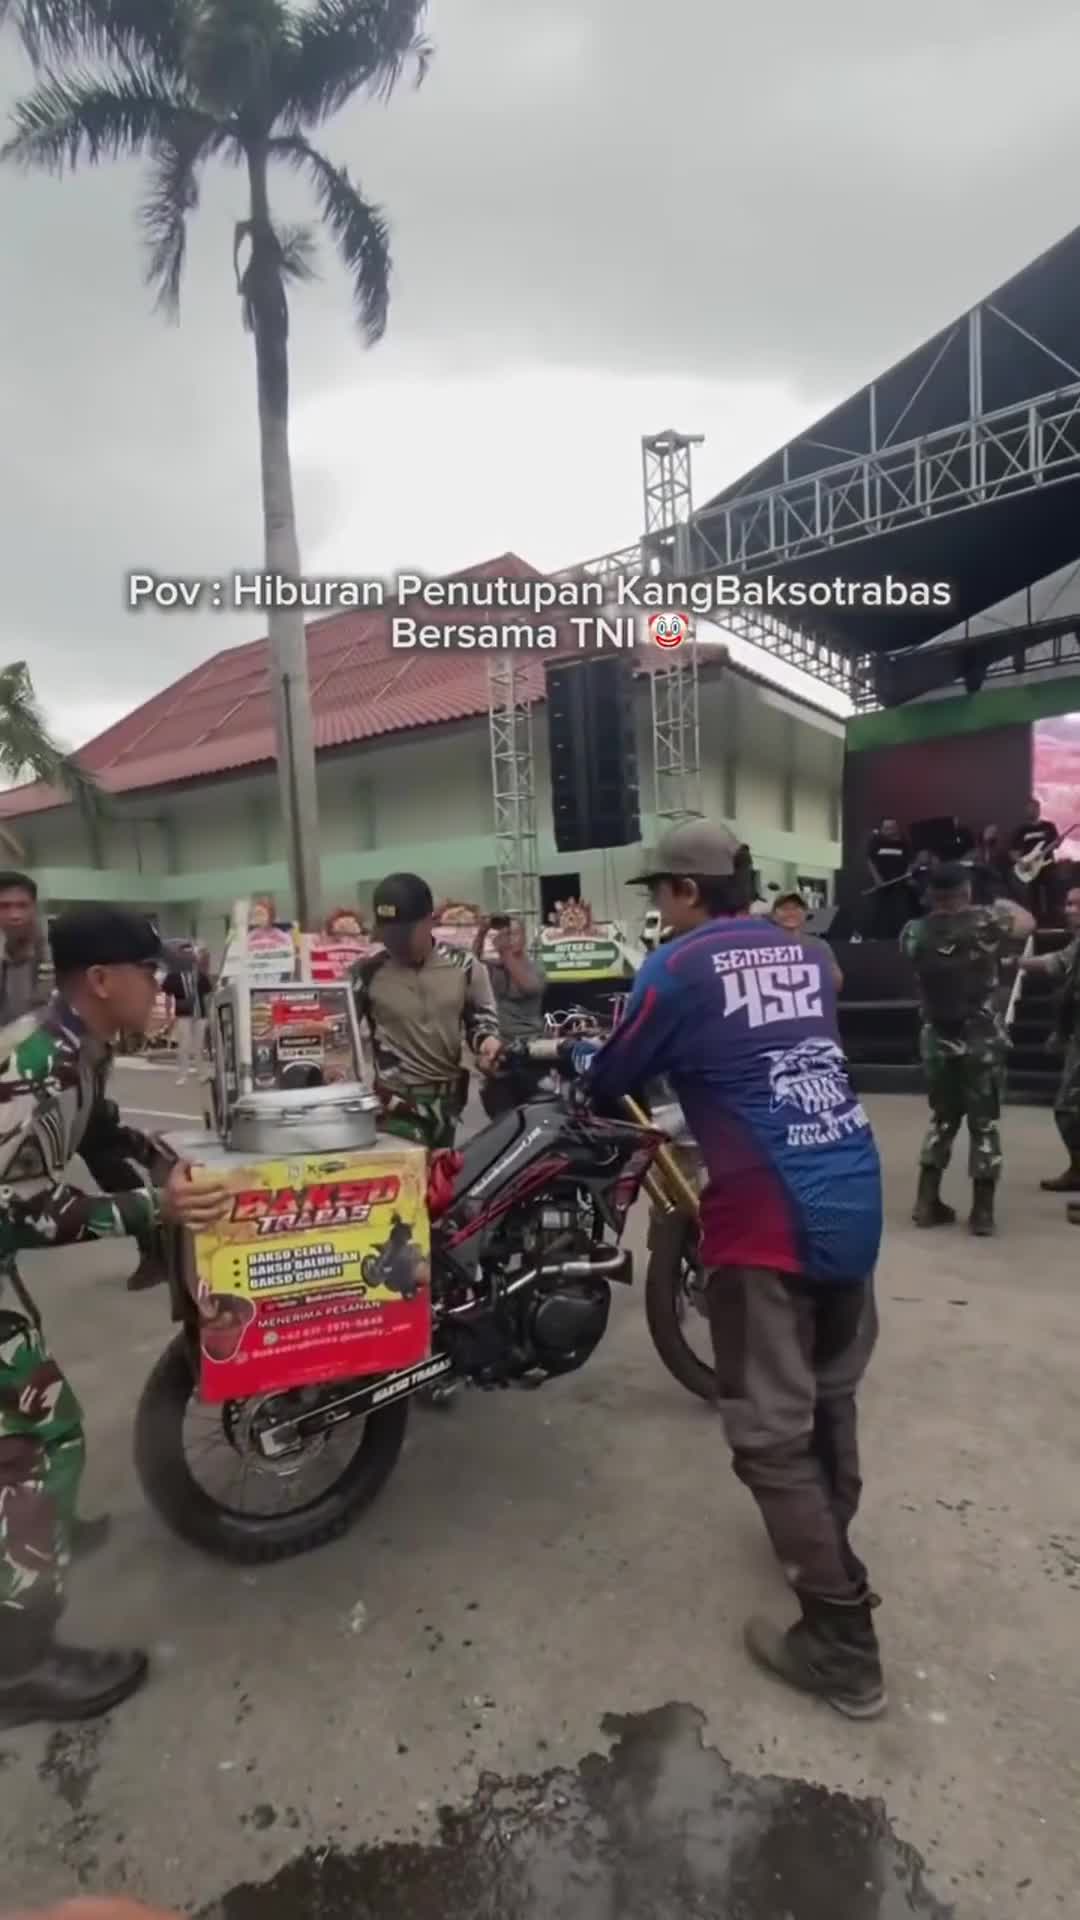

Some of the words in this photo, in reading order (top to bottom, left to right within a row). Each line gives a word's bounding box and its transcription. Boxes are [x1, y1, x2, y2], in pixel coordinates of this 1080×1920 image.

[712, 945, 803, 973] SENSEN
[722, 964, 823, 1028] 452
[231, 1176, 399, 1221] BAKSO
[258, 1204, 371, 1235] TRABAS
[249, 1250, 290, 1266] BAKSO
[249, 1261, 292, 1277] BAKSO
[250, 1273, 292, 1289] BAKSO
[257, 1309, 322, 1328] MENERIMA
[326, 1301, 381, 1316] PESANAN
